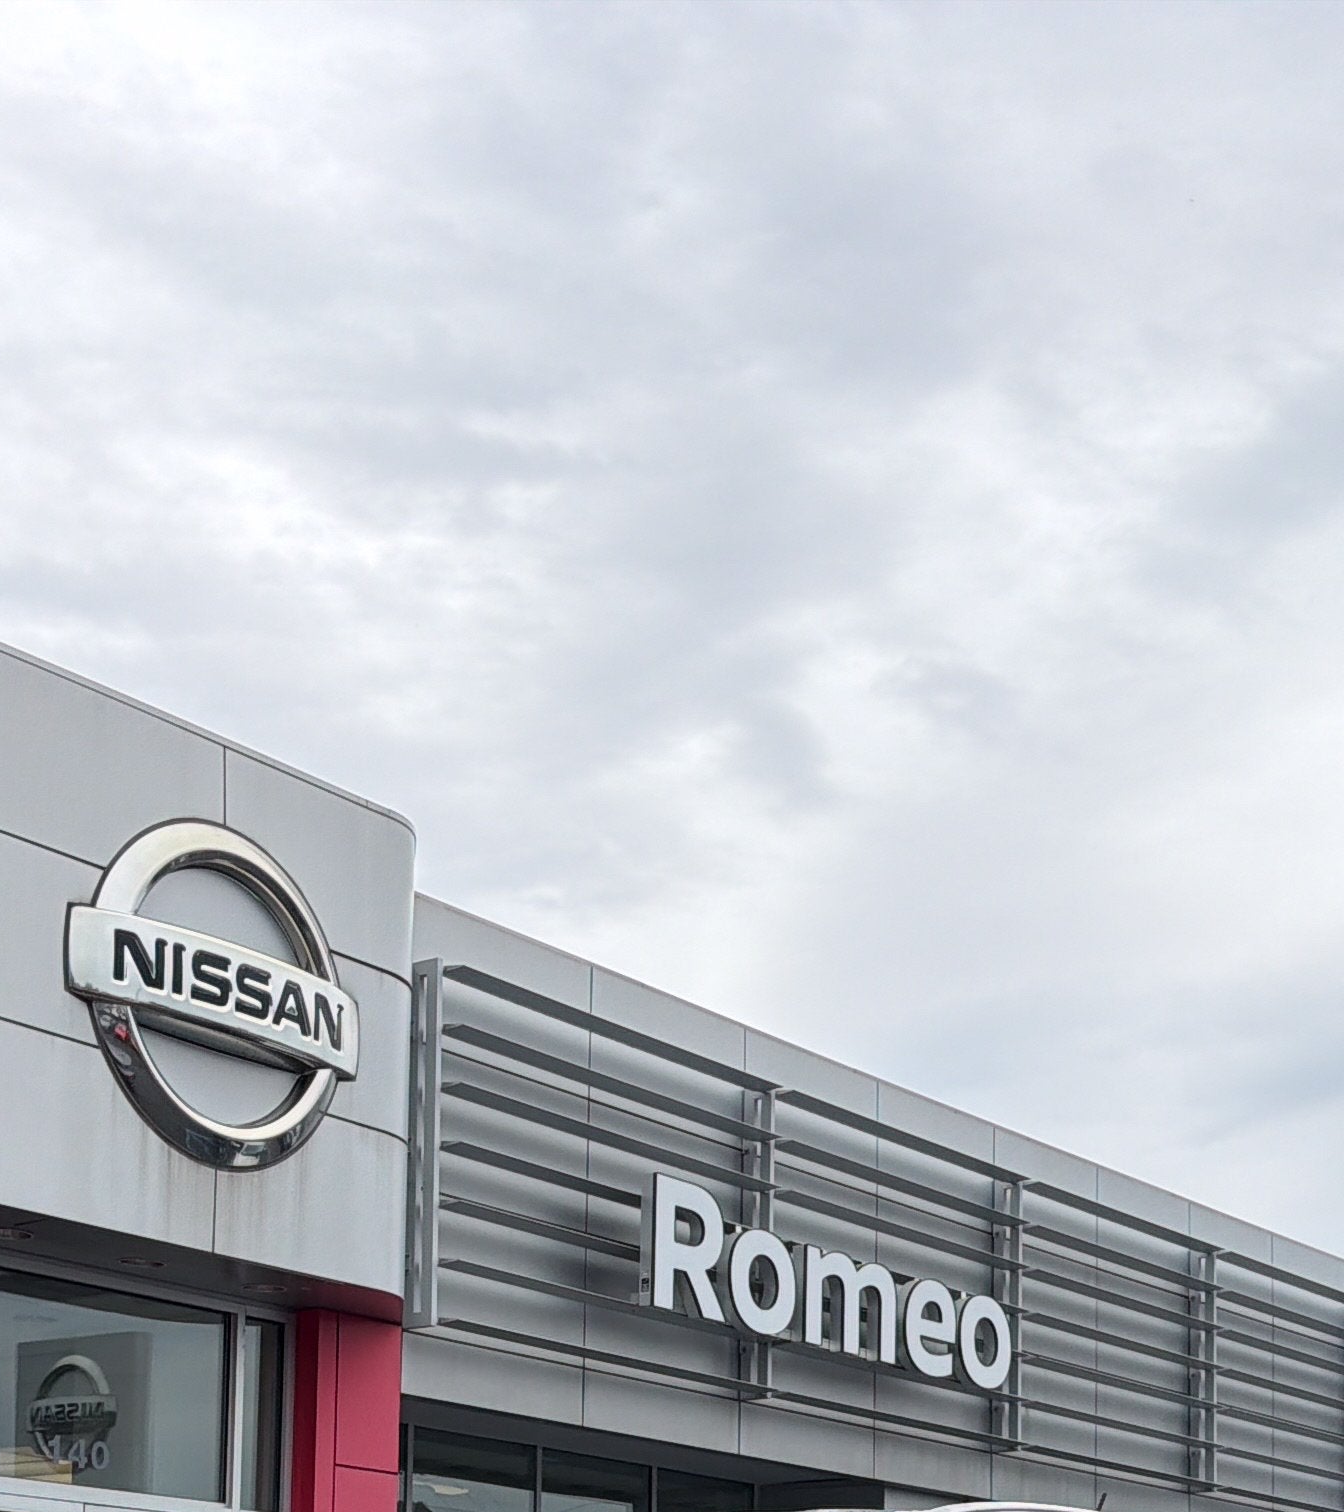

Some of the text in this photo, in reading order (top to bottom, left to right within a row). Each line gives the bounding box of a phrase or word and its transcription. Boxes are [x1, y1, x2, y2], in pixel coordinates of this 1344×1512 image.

[112, 928, 345, 1053] NISSAN
[647, 1172, 1012, 1390] Romeo
[48, 1434, 110, 1470] 140
